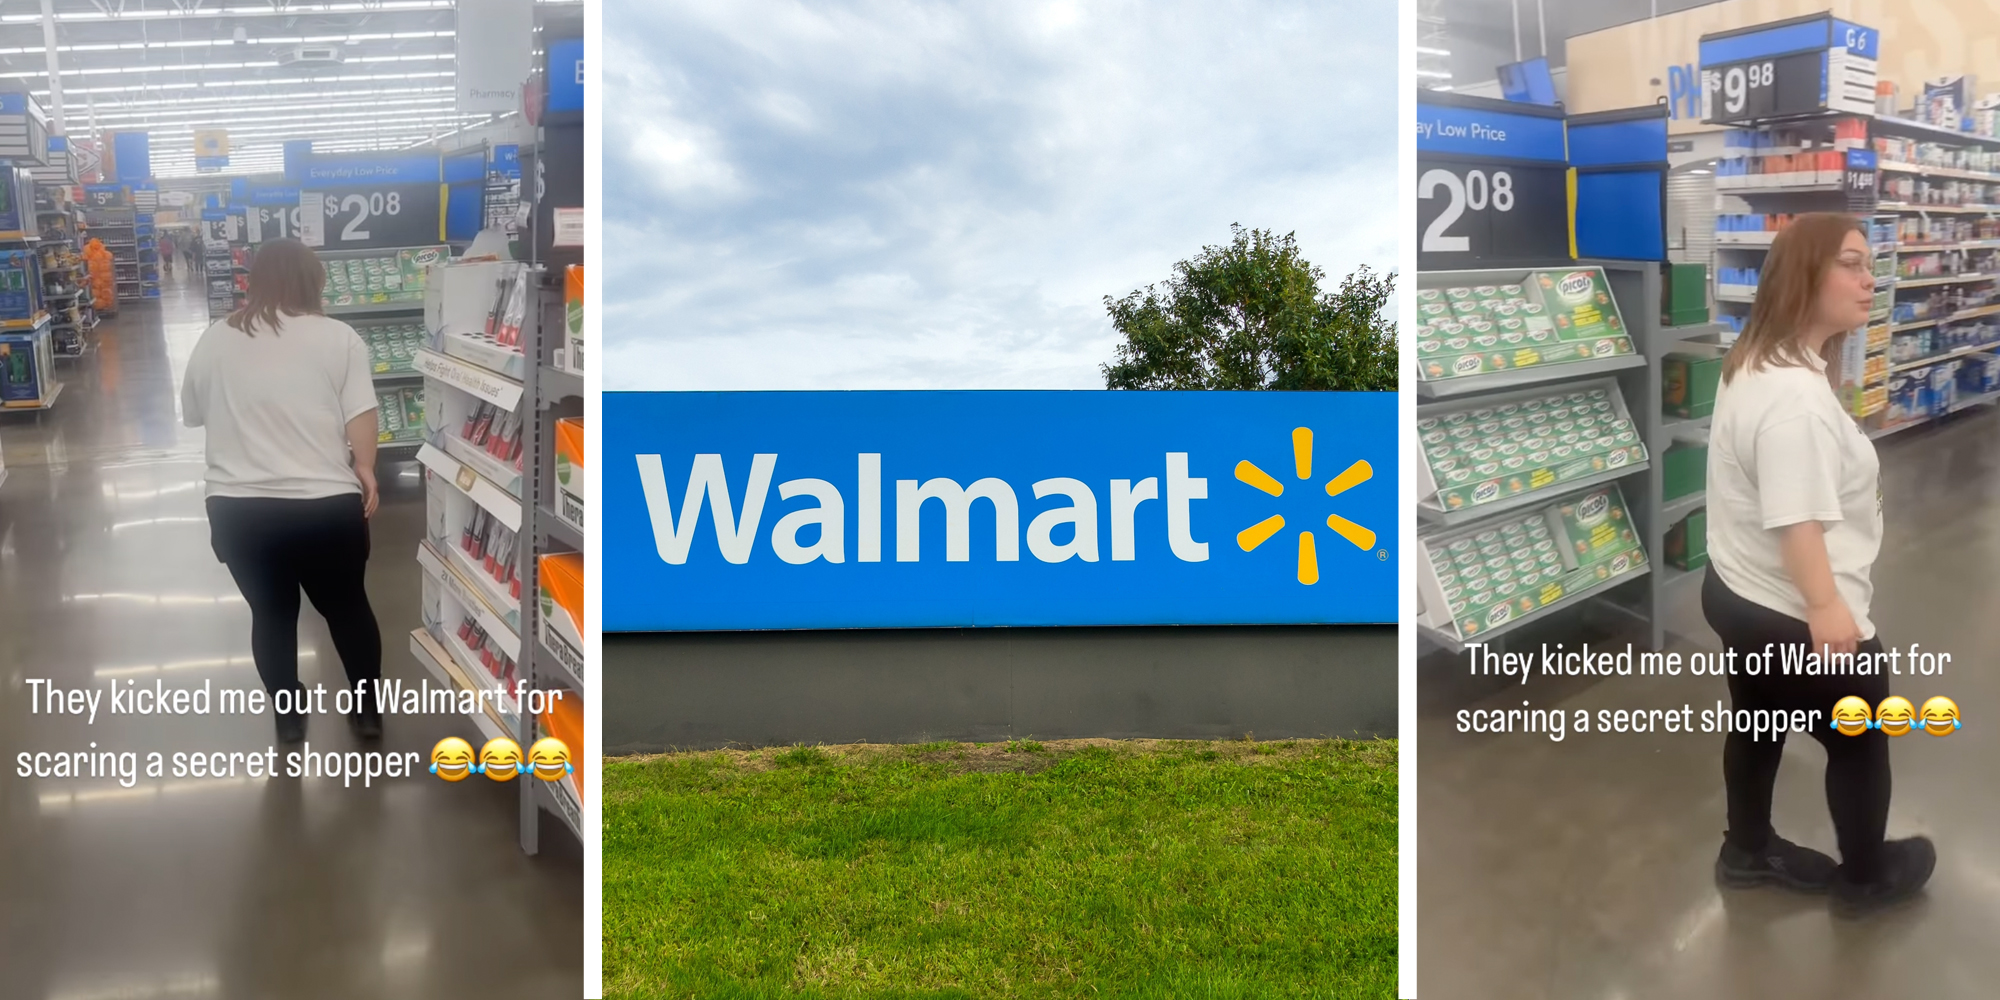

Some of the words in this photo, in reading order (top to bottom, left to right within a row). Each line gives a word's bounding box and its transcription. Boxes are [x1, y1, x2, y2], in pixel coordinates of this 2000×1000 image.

[469, 88, 516, 99] Pharmacy
[1436, 119, 1467, 138] Low
[1471, 122, 1506, 142] Price
[310, 166, 352, 178] Everyday
[354, 166, 373, 176] Low
[376, 165, 398, 175] Price
[635, 452, 1210, 566] Walmart
